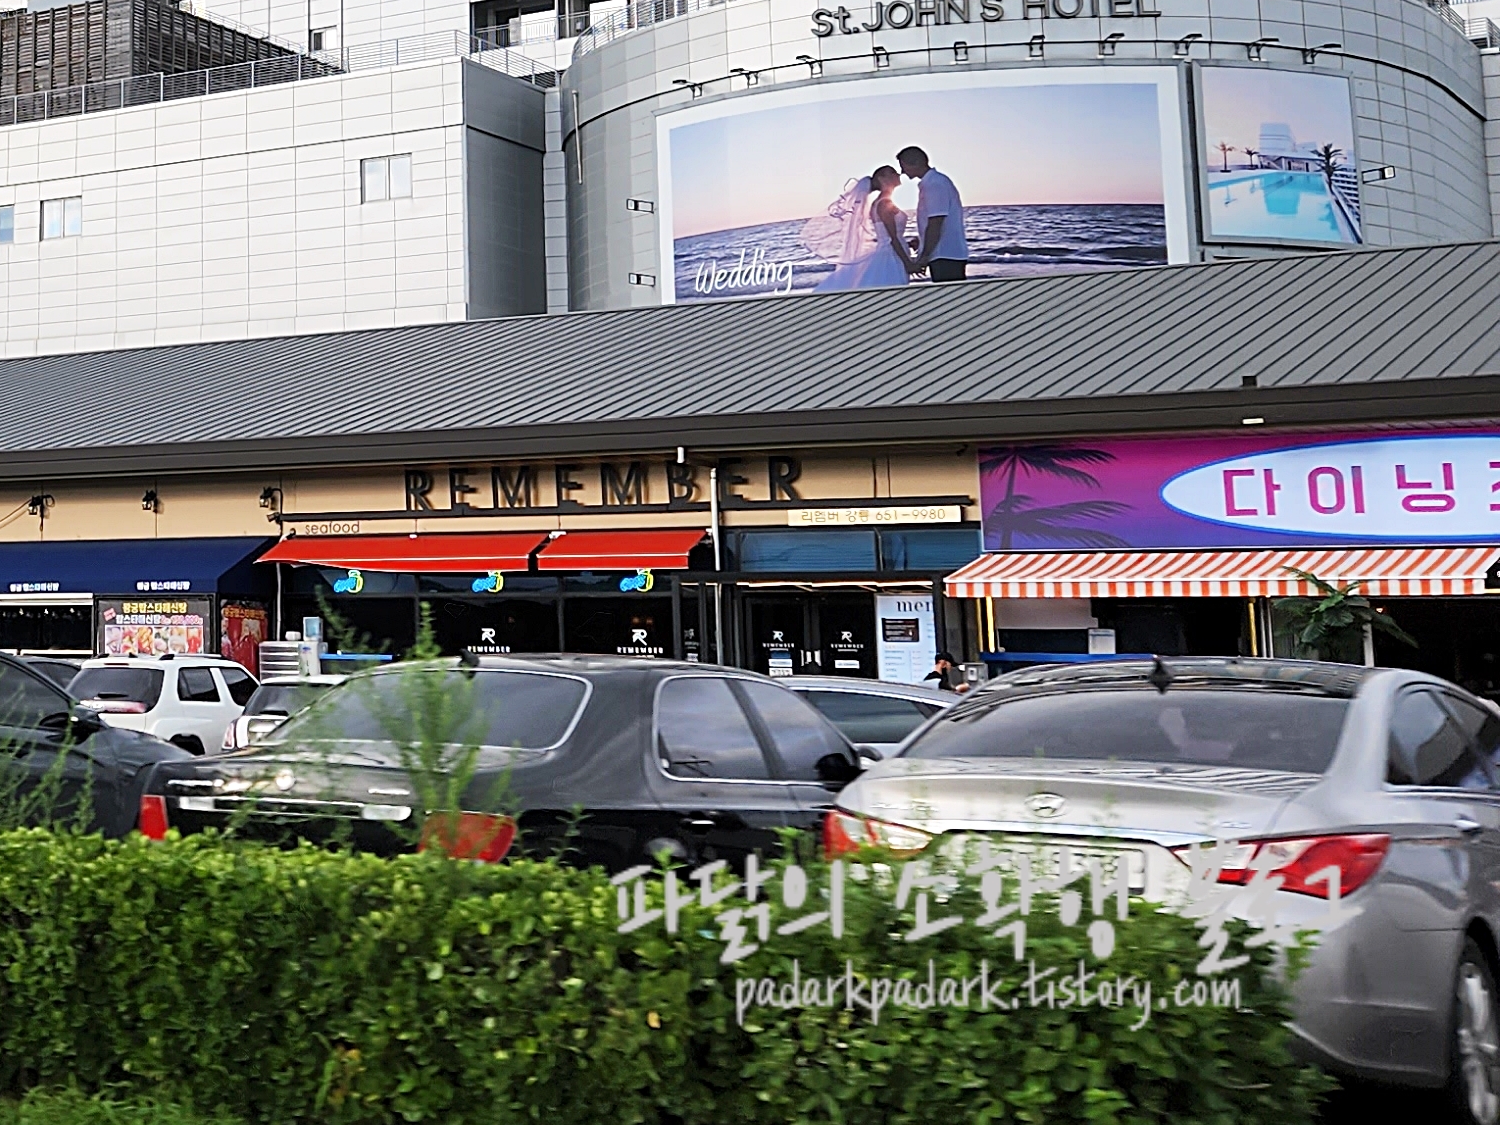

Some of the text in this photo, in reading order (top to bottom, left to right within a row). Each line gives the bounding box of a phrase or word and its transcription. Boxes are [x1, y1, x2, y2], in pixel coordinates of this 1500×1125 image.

[695, 247, 793, 295] Wedding
[405, 456, 802, 511] REMEMBER
[1222, 461, 1500, 517] 다이닝
[304, 520, 360, 534] seafood
[875, 508, 946, 521] 651-9980
